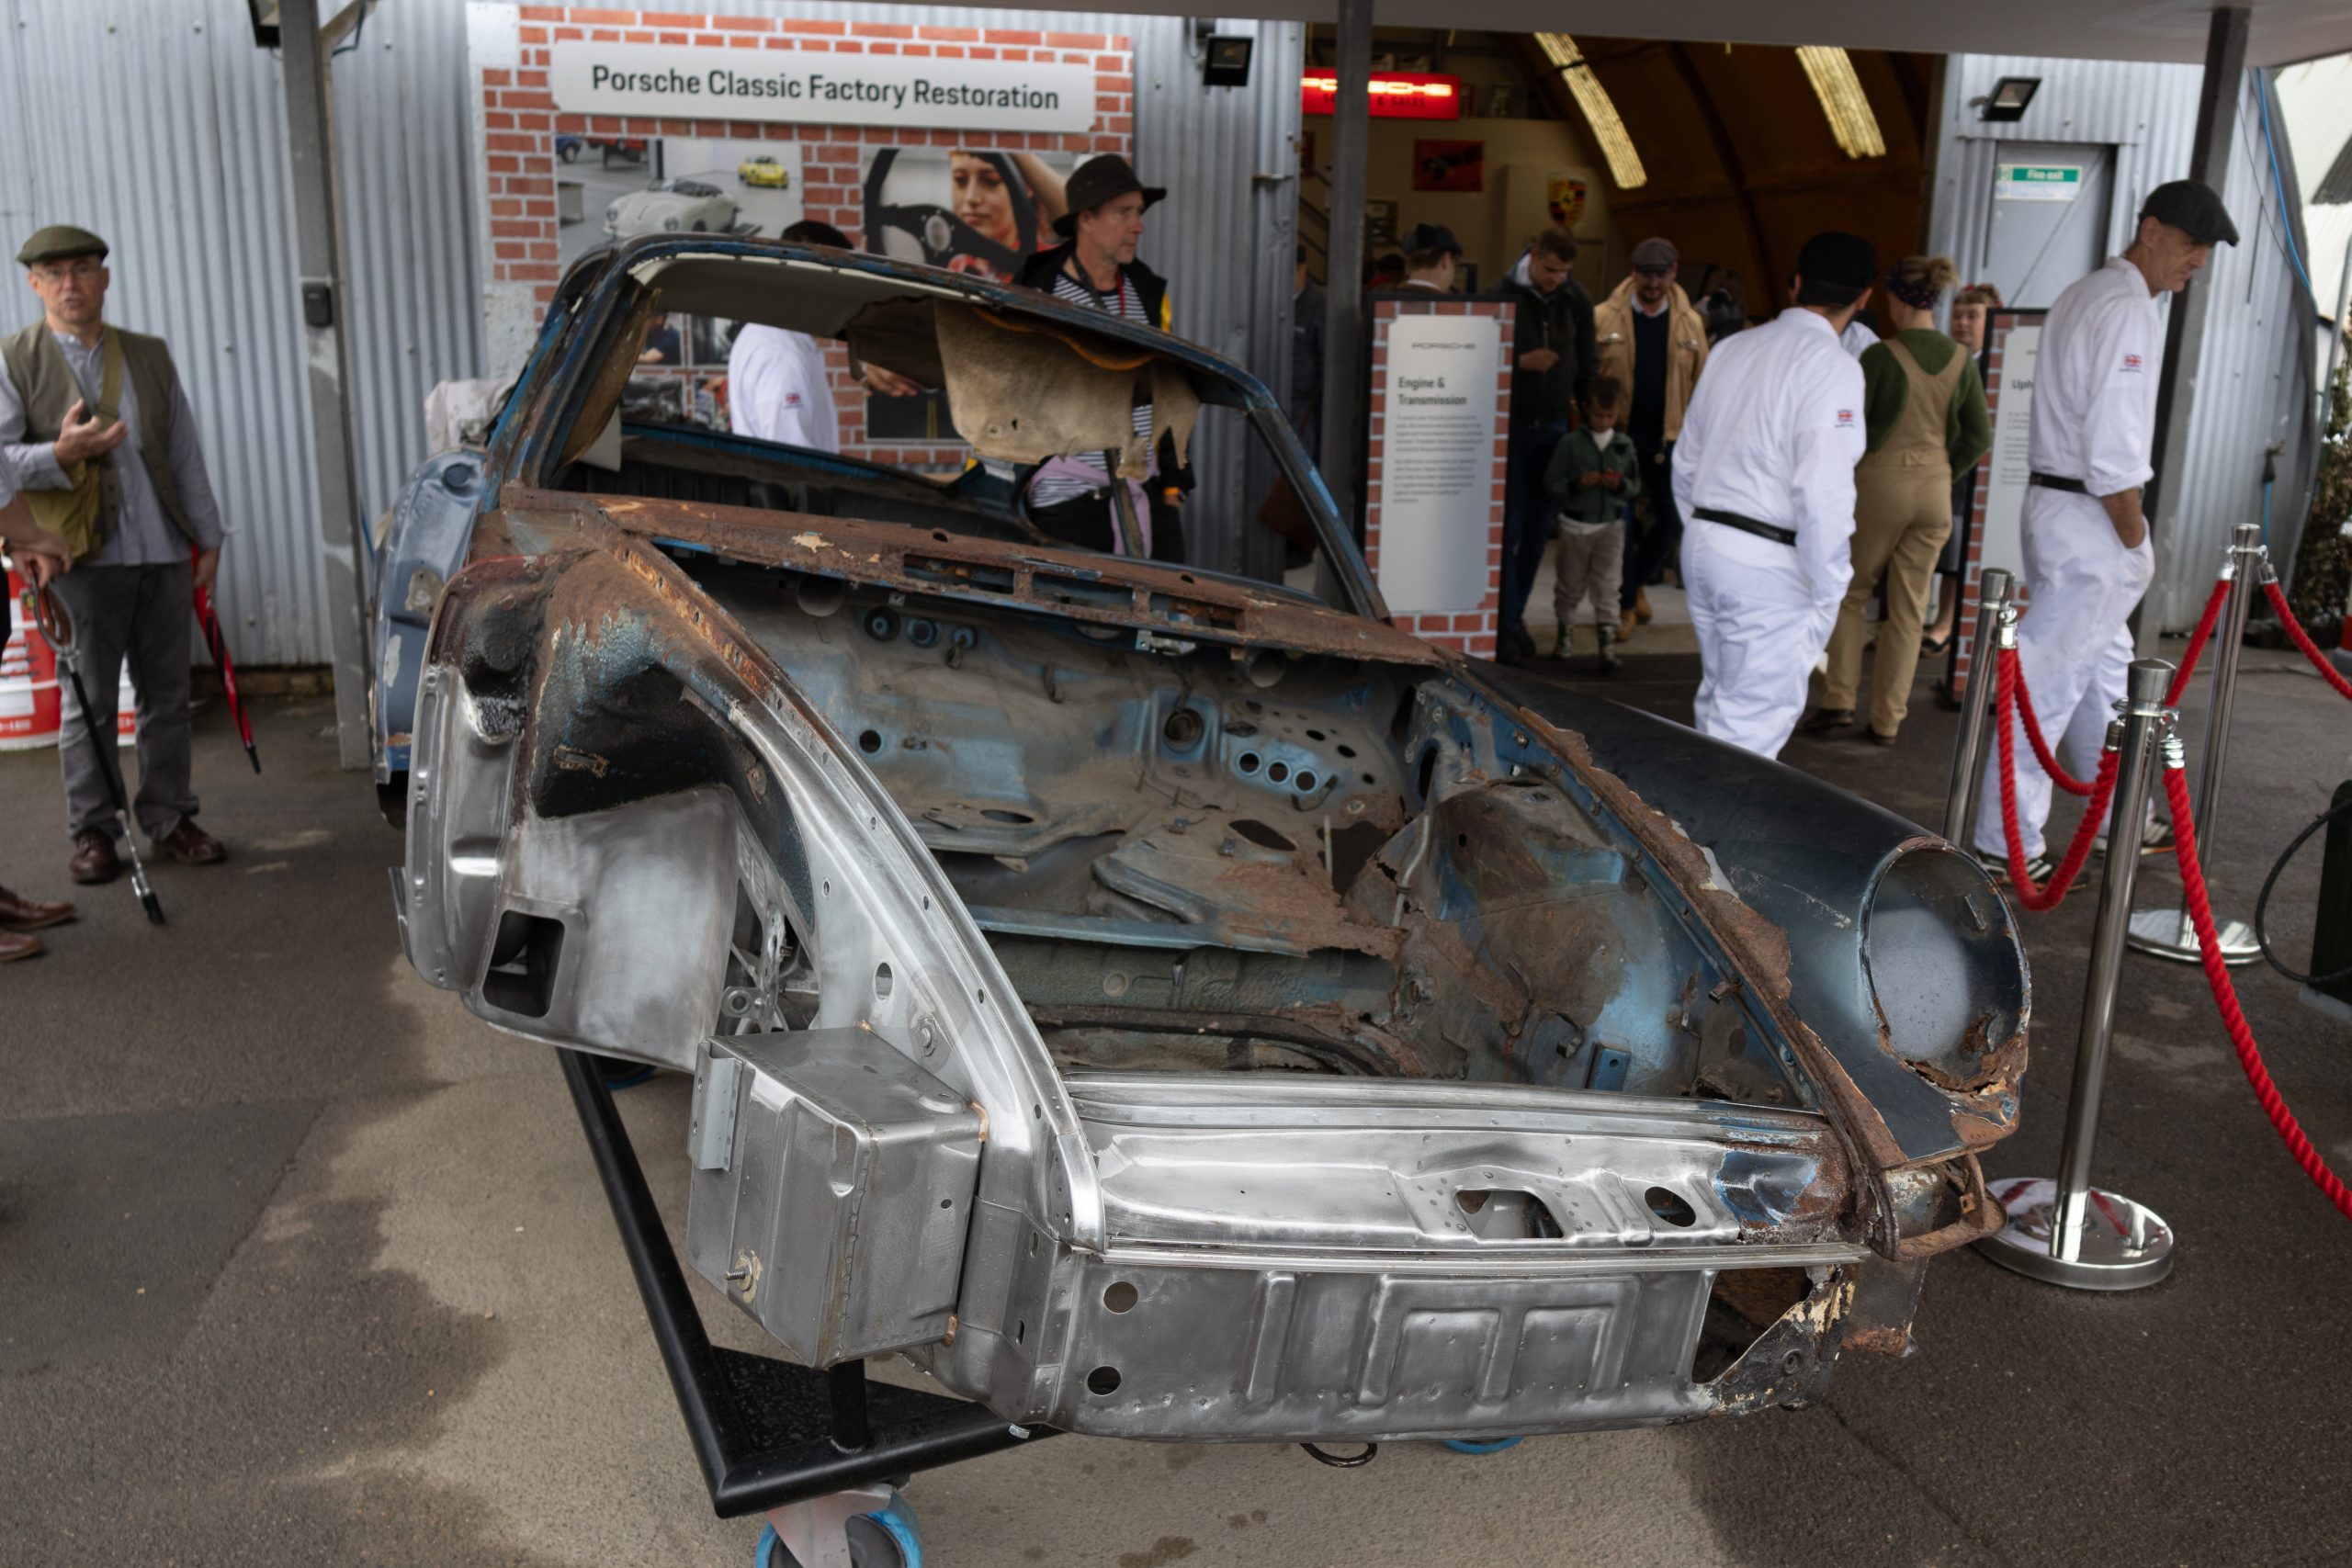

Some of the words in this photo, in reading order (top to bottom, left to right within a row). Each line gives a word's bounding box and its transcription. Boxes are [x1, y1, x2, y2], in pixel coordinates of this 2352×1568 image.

[593, 65, 701, 95] Porsche
[708, 70, 802, 99] Classic
[809, 73, 906, 109] Factory
[914, 79, 1059, 109] Restoration
[1301, 77, 1452, 96] POSCHE
[1391, 96, 1426, 107] SALES
[2027, 169, 2045, 179] Fire
[1398, 377, 1435, 390] Engine
[1437, 377, 1445, 389] &
[1398, 394, 1467, 405] Transmission
